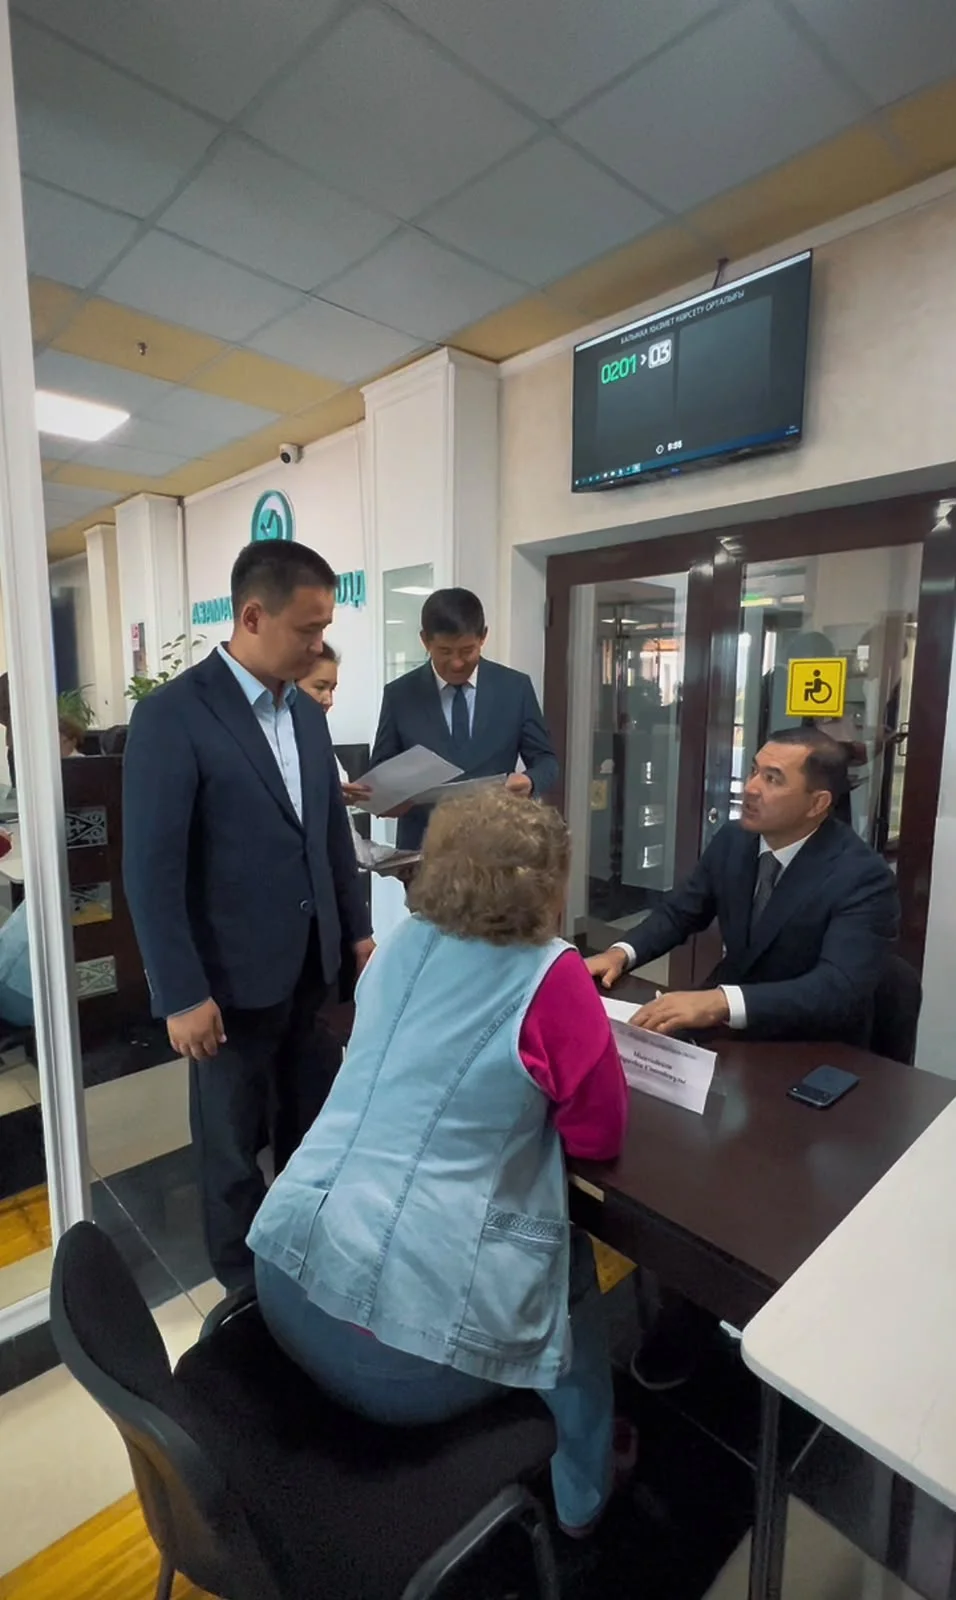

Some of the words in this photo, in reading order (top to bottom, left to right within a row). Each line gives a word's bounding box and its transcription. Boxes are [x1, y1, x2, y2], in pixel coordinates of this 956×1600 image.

[601, 353, 636, 384] 0201
[649, 341, 671, 366] 03
[192, 597, 233, 624] АЗАМА
